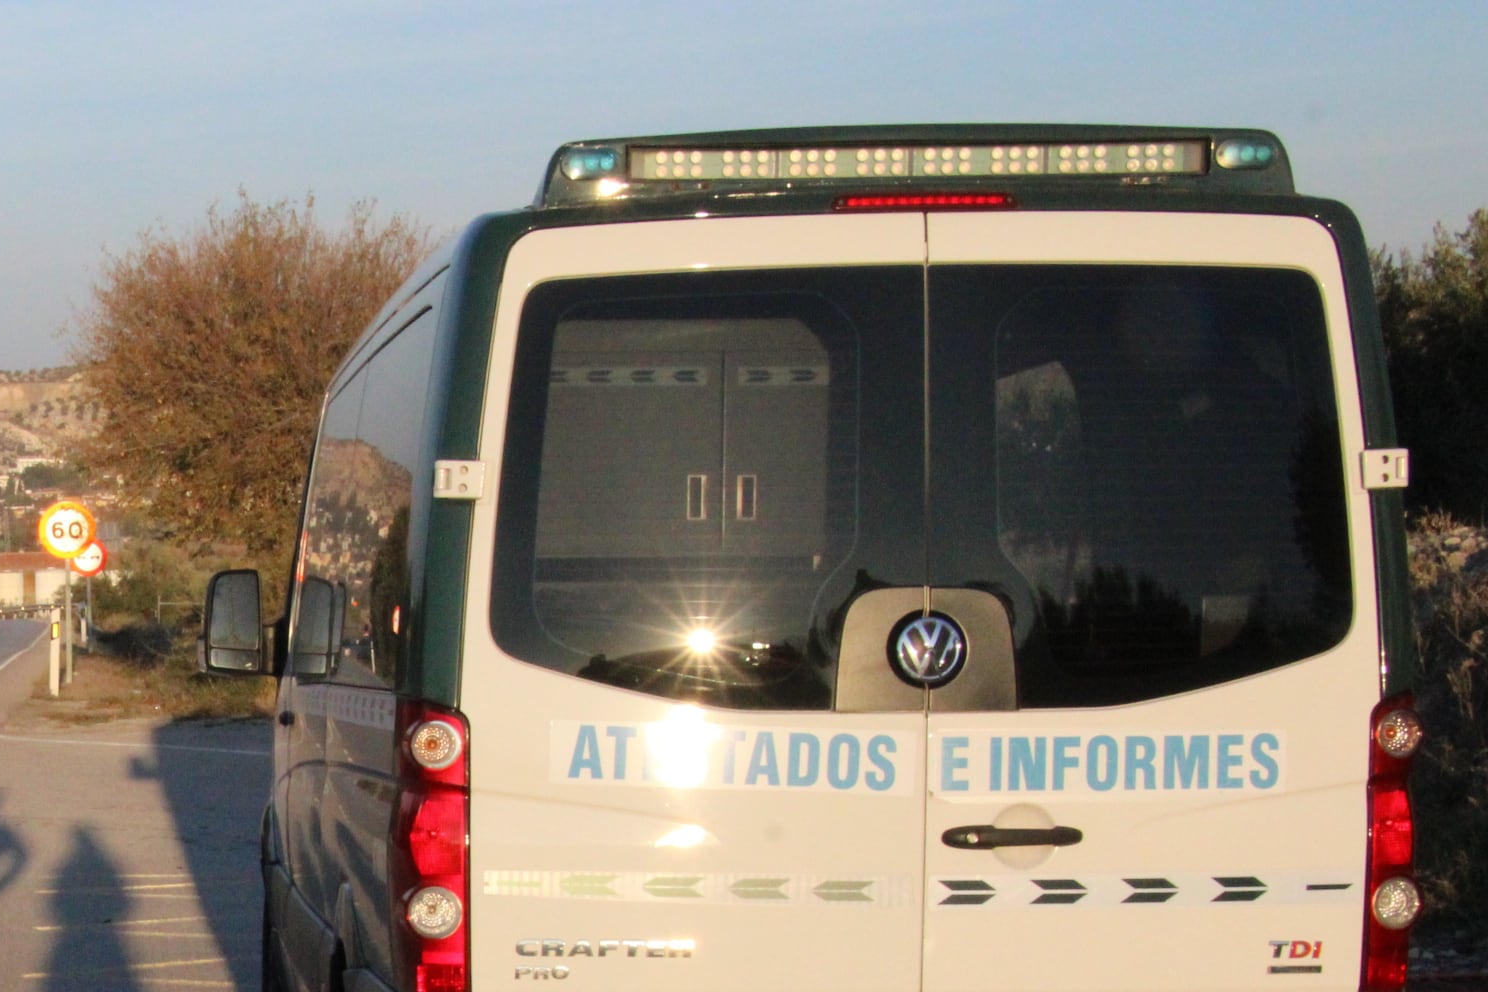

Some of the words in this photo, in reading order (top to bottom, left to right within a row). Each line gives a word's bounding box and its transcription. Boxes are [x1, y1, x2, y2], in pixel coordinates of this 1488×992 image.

[52, 521, 83, 539] 60
[568, 724, 898, 792] ATTADOS
[941, 736, 969, 791] E
[989, 732, 1280, 792] INFORMES
[1268, 940, 1323, 959] TDI
[514, 964, 570, 981] PRO
